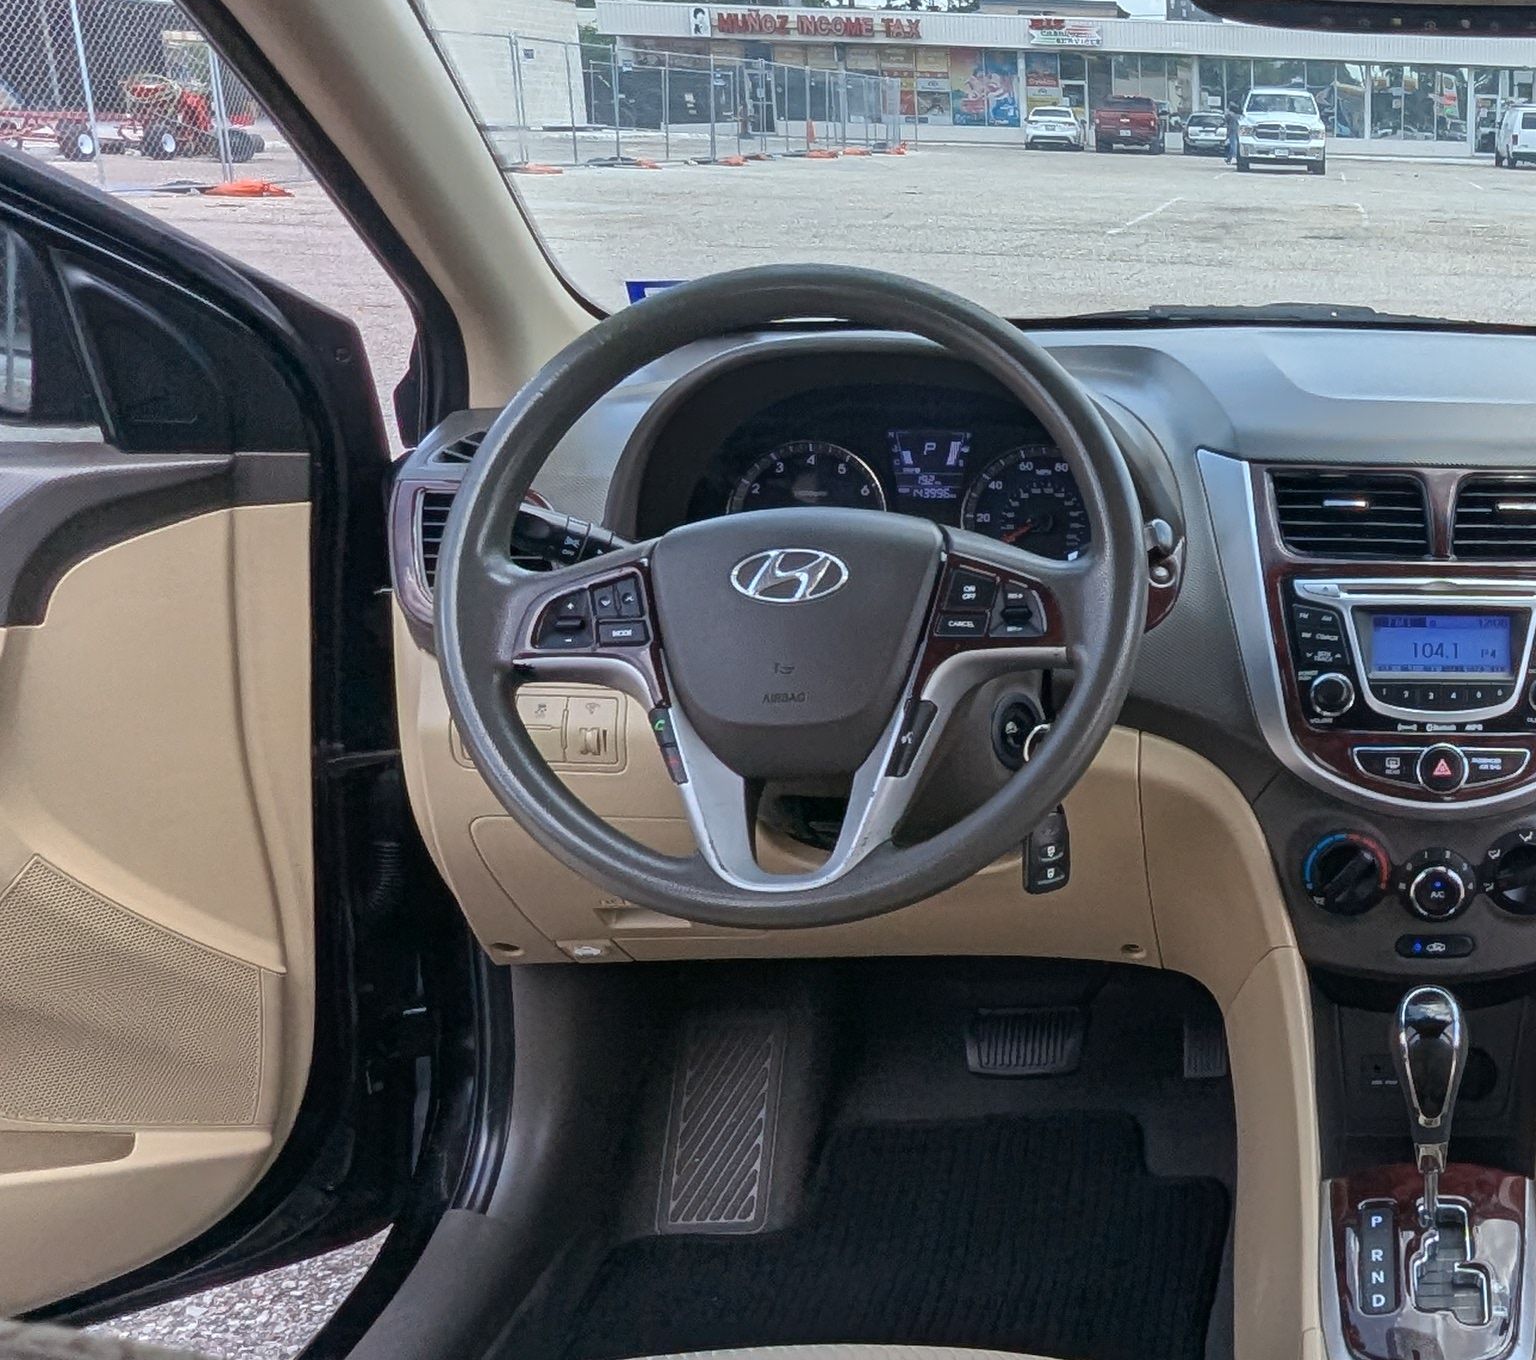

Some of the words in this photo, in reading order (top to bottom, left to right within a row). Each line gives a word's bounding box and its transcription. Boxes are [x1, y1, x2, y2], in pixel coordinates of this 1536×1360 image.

[717, 8, 791, 35] MUÑOZ
[796, 15, 875, 38] INCOME
[881, 18, 922, 39] TAX
[923, 442, 937, 456] P
[806, 455, 816, 465] 4
[775, 462, 784, 473] 3
[1019, 461, 1034, 471] 60
[1054, 462, 1069, 473] 80
[751, 484, 761, 495] 2
[988, 480, 1003, 490] 40
[861, 485, 870, 497] 6
[976, 513, 991, 523] 20
[948, 620, 975, 628] CANCEL
[1412, 642, 1458, 659] 104.1
[1371, 1215, 1383, 1228] P
[1371, 1249, 1384, 1262] R
[1371, 1270, 1385, 1284] N
[1372, 1294, 1386, 1308] D
